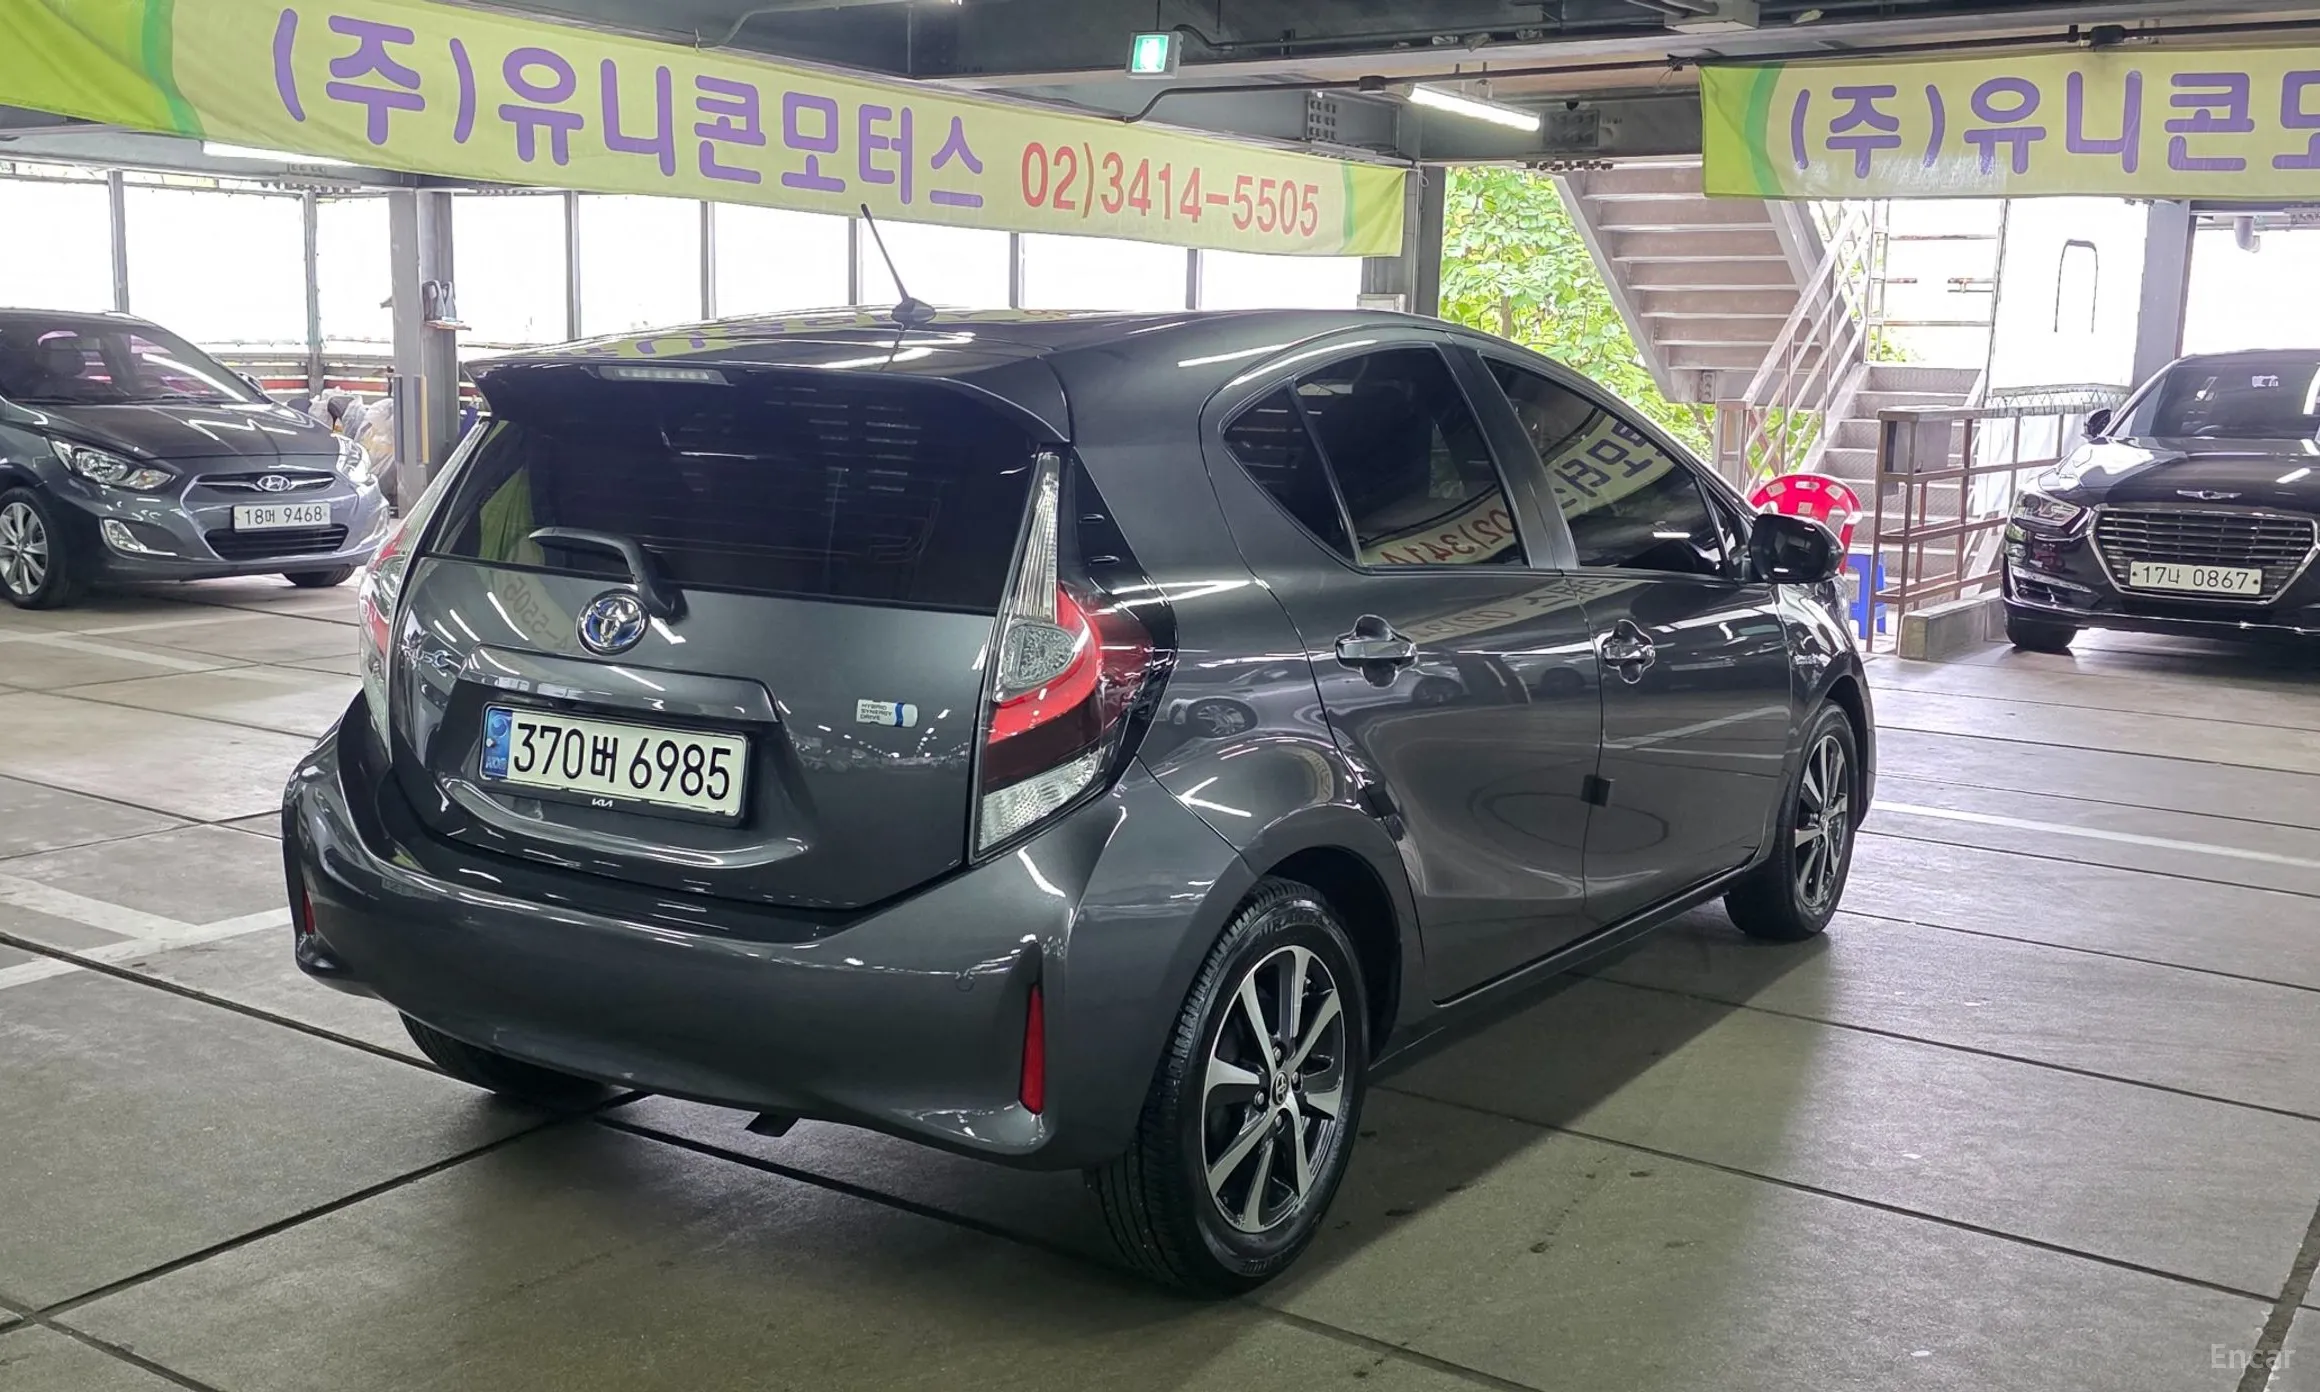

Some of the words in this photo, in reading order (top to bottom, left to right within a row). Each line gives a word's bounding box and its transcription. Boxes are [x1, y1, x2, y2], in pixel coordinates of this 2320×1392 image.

[272, 7, 985, 208] (주)유니콘모터스
[1020, 141, 1320, 238] 02)3414-5505
[244, 508, 276, 525] 18머
[283, 506, 322, 523] 9468
[2143, 565, 2181, 585] 17나
[2193, 568, 2249, 590] 0867
[513, 722, 620, 783] 370버
[628, 737, 732, 800] 6985
